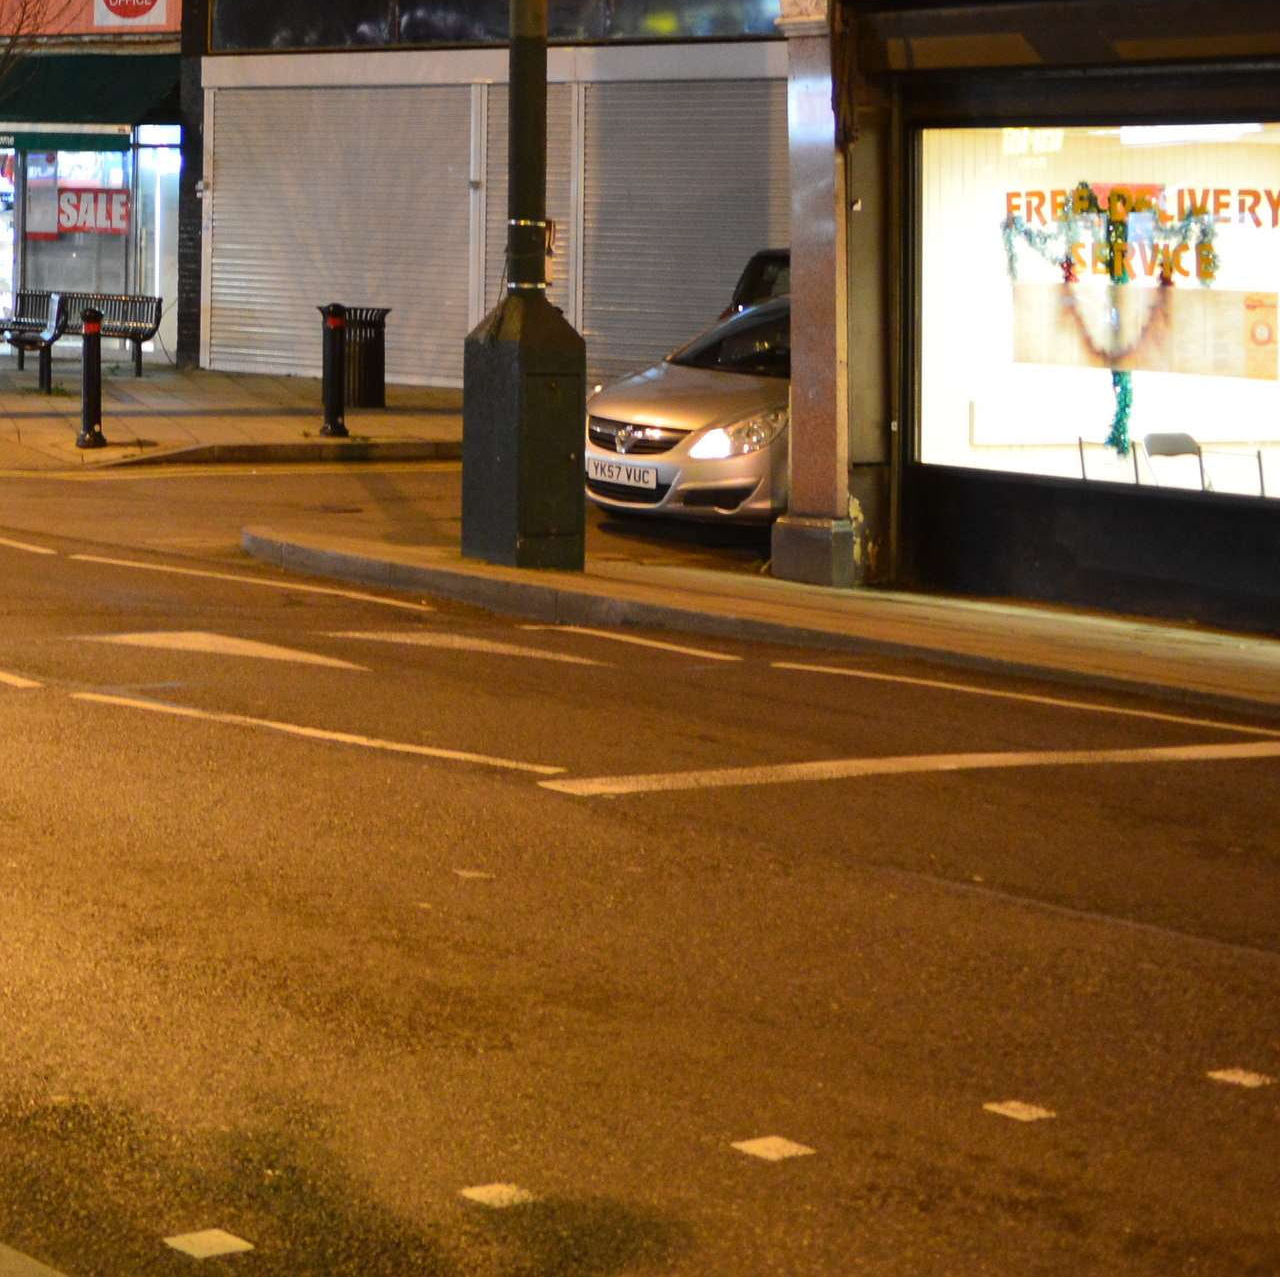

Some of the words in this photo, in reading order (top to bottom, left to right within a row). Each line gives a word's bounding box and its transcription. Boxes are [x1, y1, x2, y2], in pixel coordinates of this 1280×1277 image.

[60, 191, 128, 229] SALE
[1005, 188, 1090, 226] FREE
[1070, 242, 1217, 281] SERVICE
[593, 461, 622, 480] YK57
[625, 467, 650, 485] VUC
